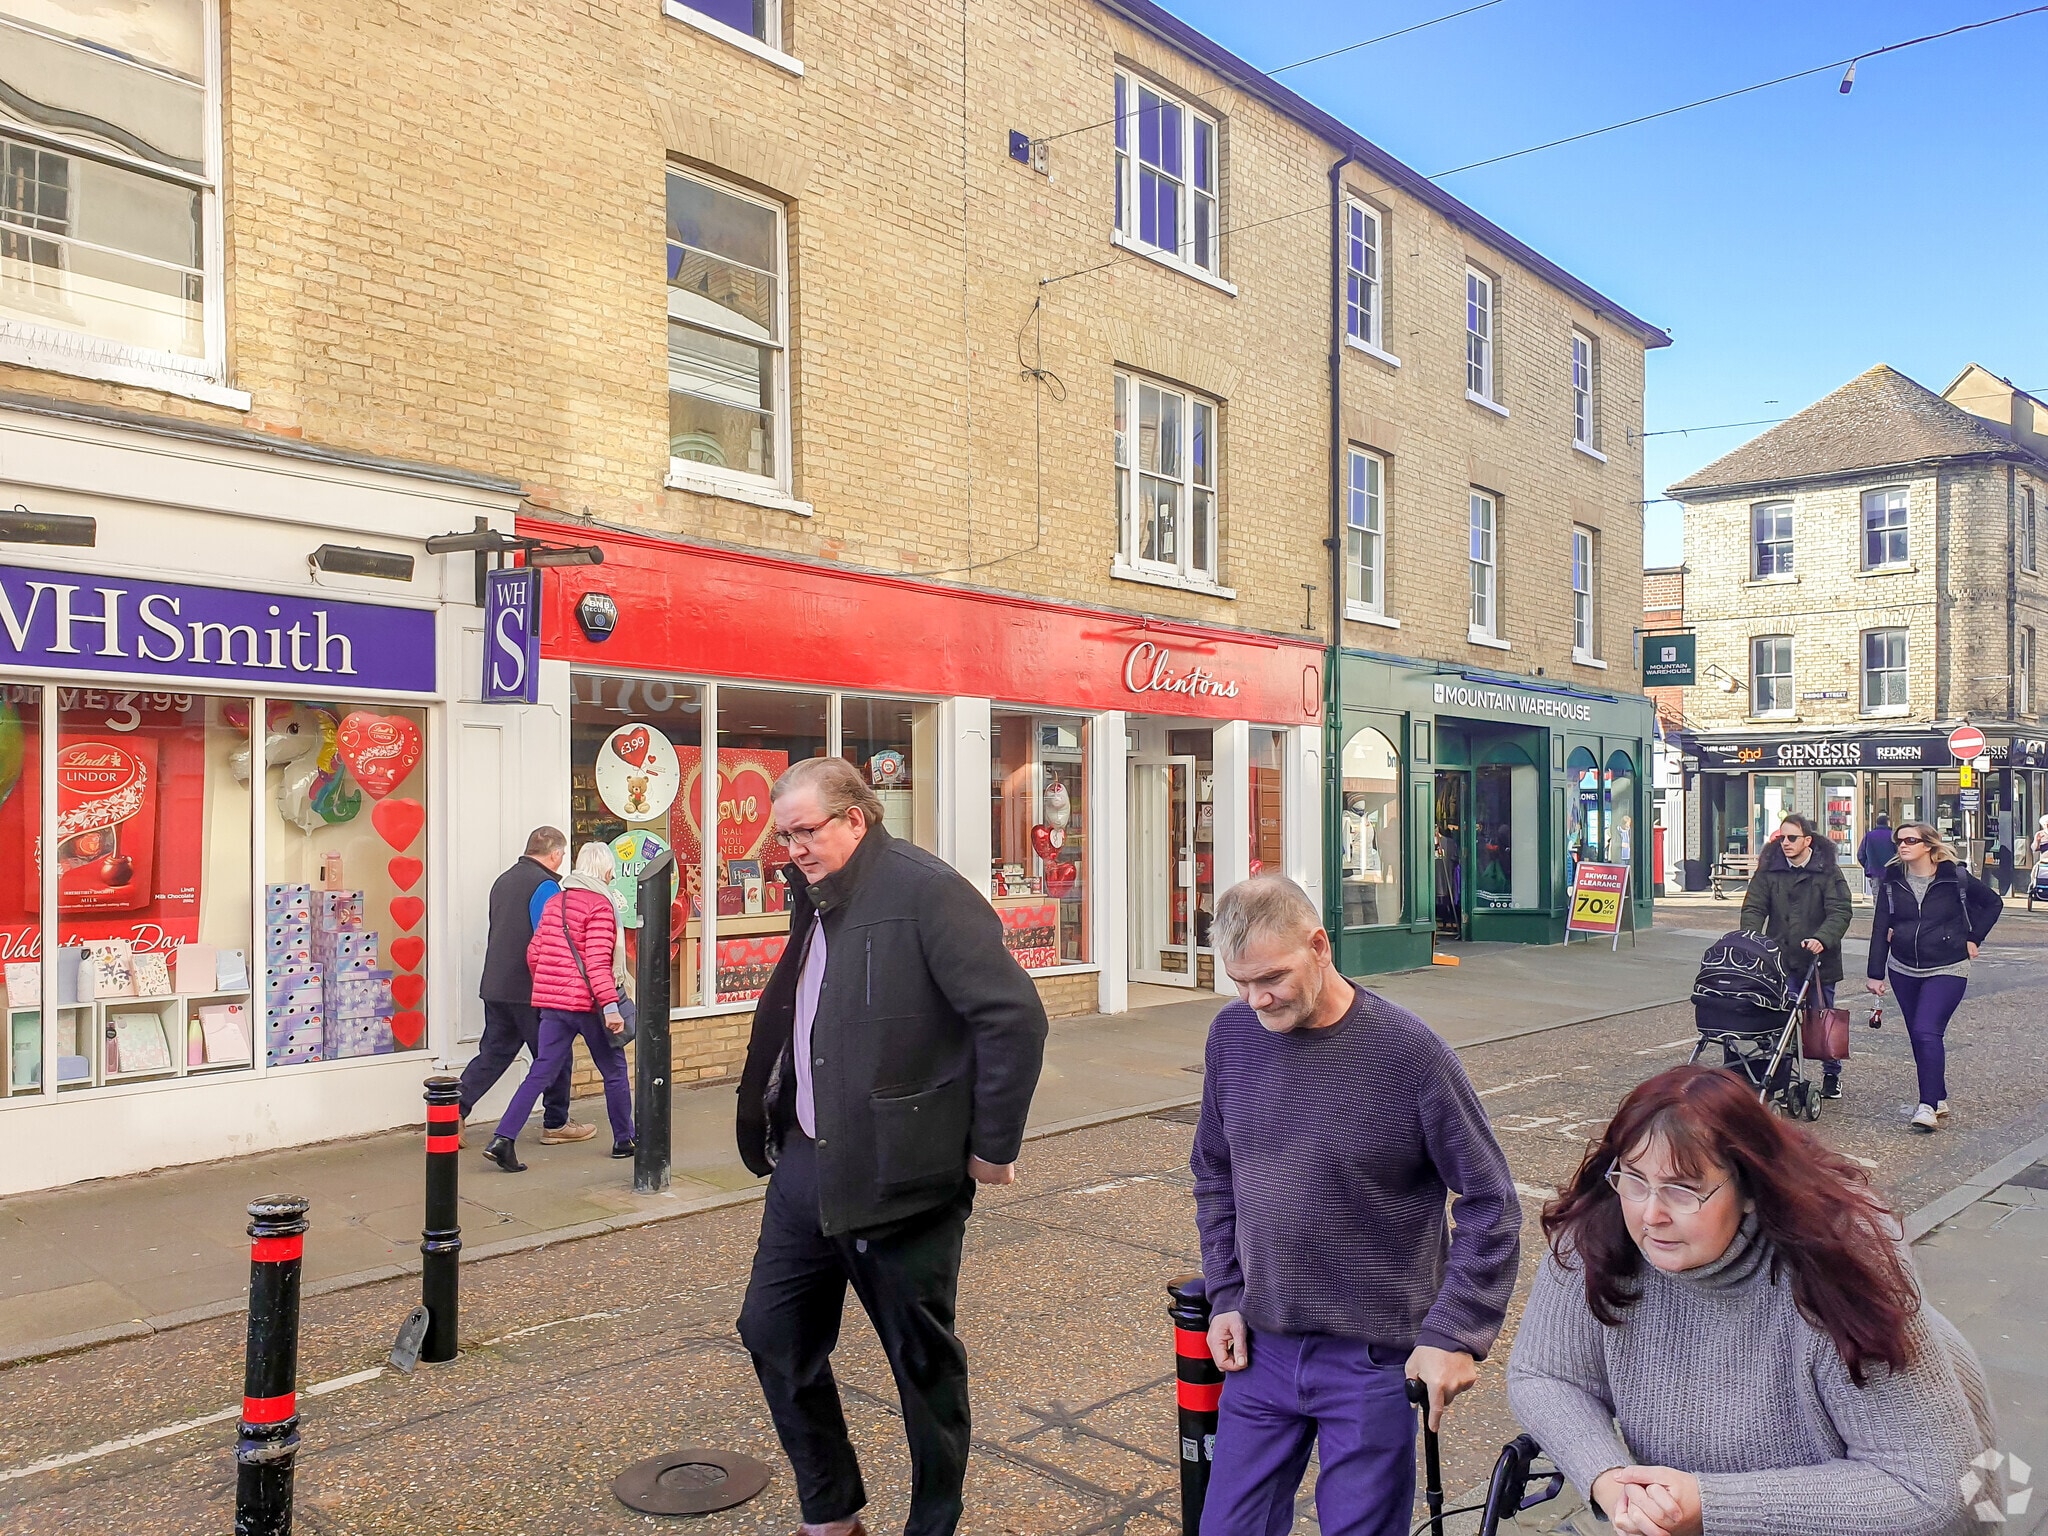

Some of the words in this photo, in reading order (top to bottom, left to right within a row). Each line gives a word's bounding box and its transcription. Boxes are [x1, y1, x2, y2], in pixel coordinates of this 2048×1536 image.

[496, 581, 527, 606] WH
[493, 607, 525, 692] S
[1126, 641, 1239, 698] Clintons
[1445, 686, 1516, 712] MOUNTAIN
[1518, 697, 1591, 721] WAREHOUSE
[620, 736, 645, 755] £3.99
[1777, 742, 1861, 759] GENESIS
[1876, 746, 1921, 757] REDKEN
[1984, 745, 2008, 755] ESIS
[64, 751, 110, 767] Lindt
[1738, 747, 1762, 764] ghd
[1808, 758, 1861, 766] COMPANY
[66, 771, 117, 783] LINDOR
[721, 827, 729, 836] IS
[730, 828, 744, 836] ALL
[723, 837, 742, 845] YOU
[720, 845, 745, 855] NEED
[1584, 872, 1618, 880] SKIWEAR
[1579, 879, 1621, 889] CLEARANCE
[1577, 897, 1615, 914] 70%
